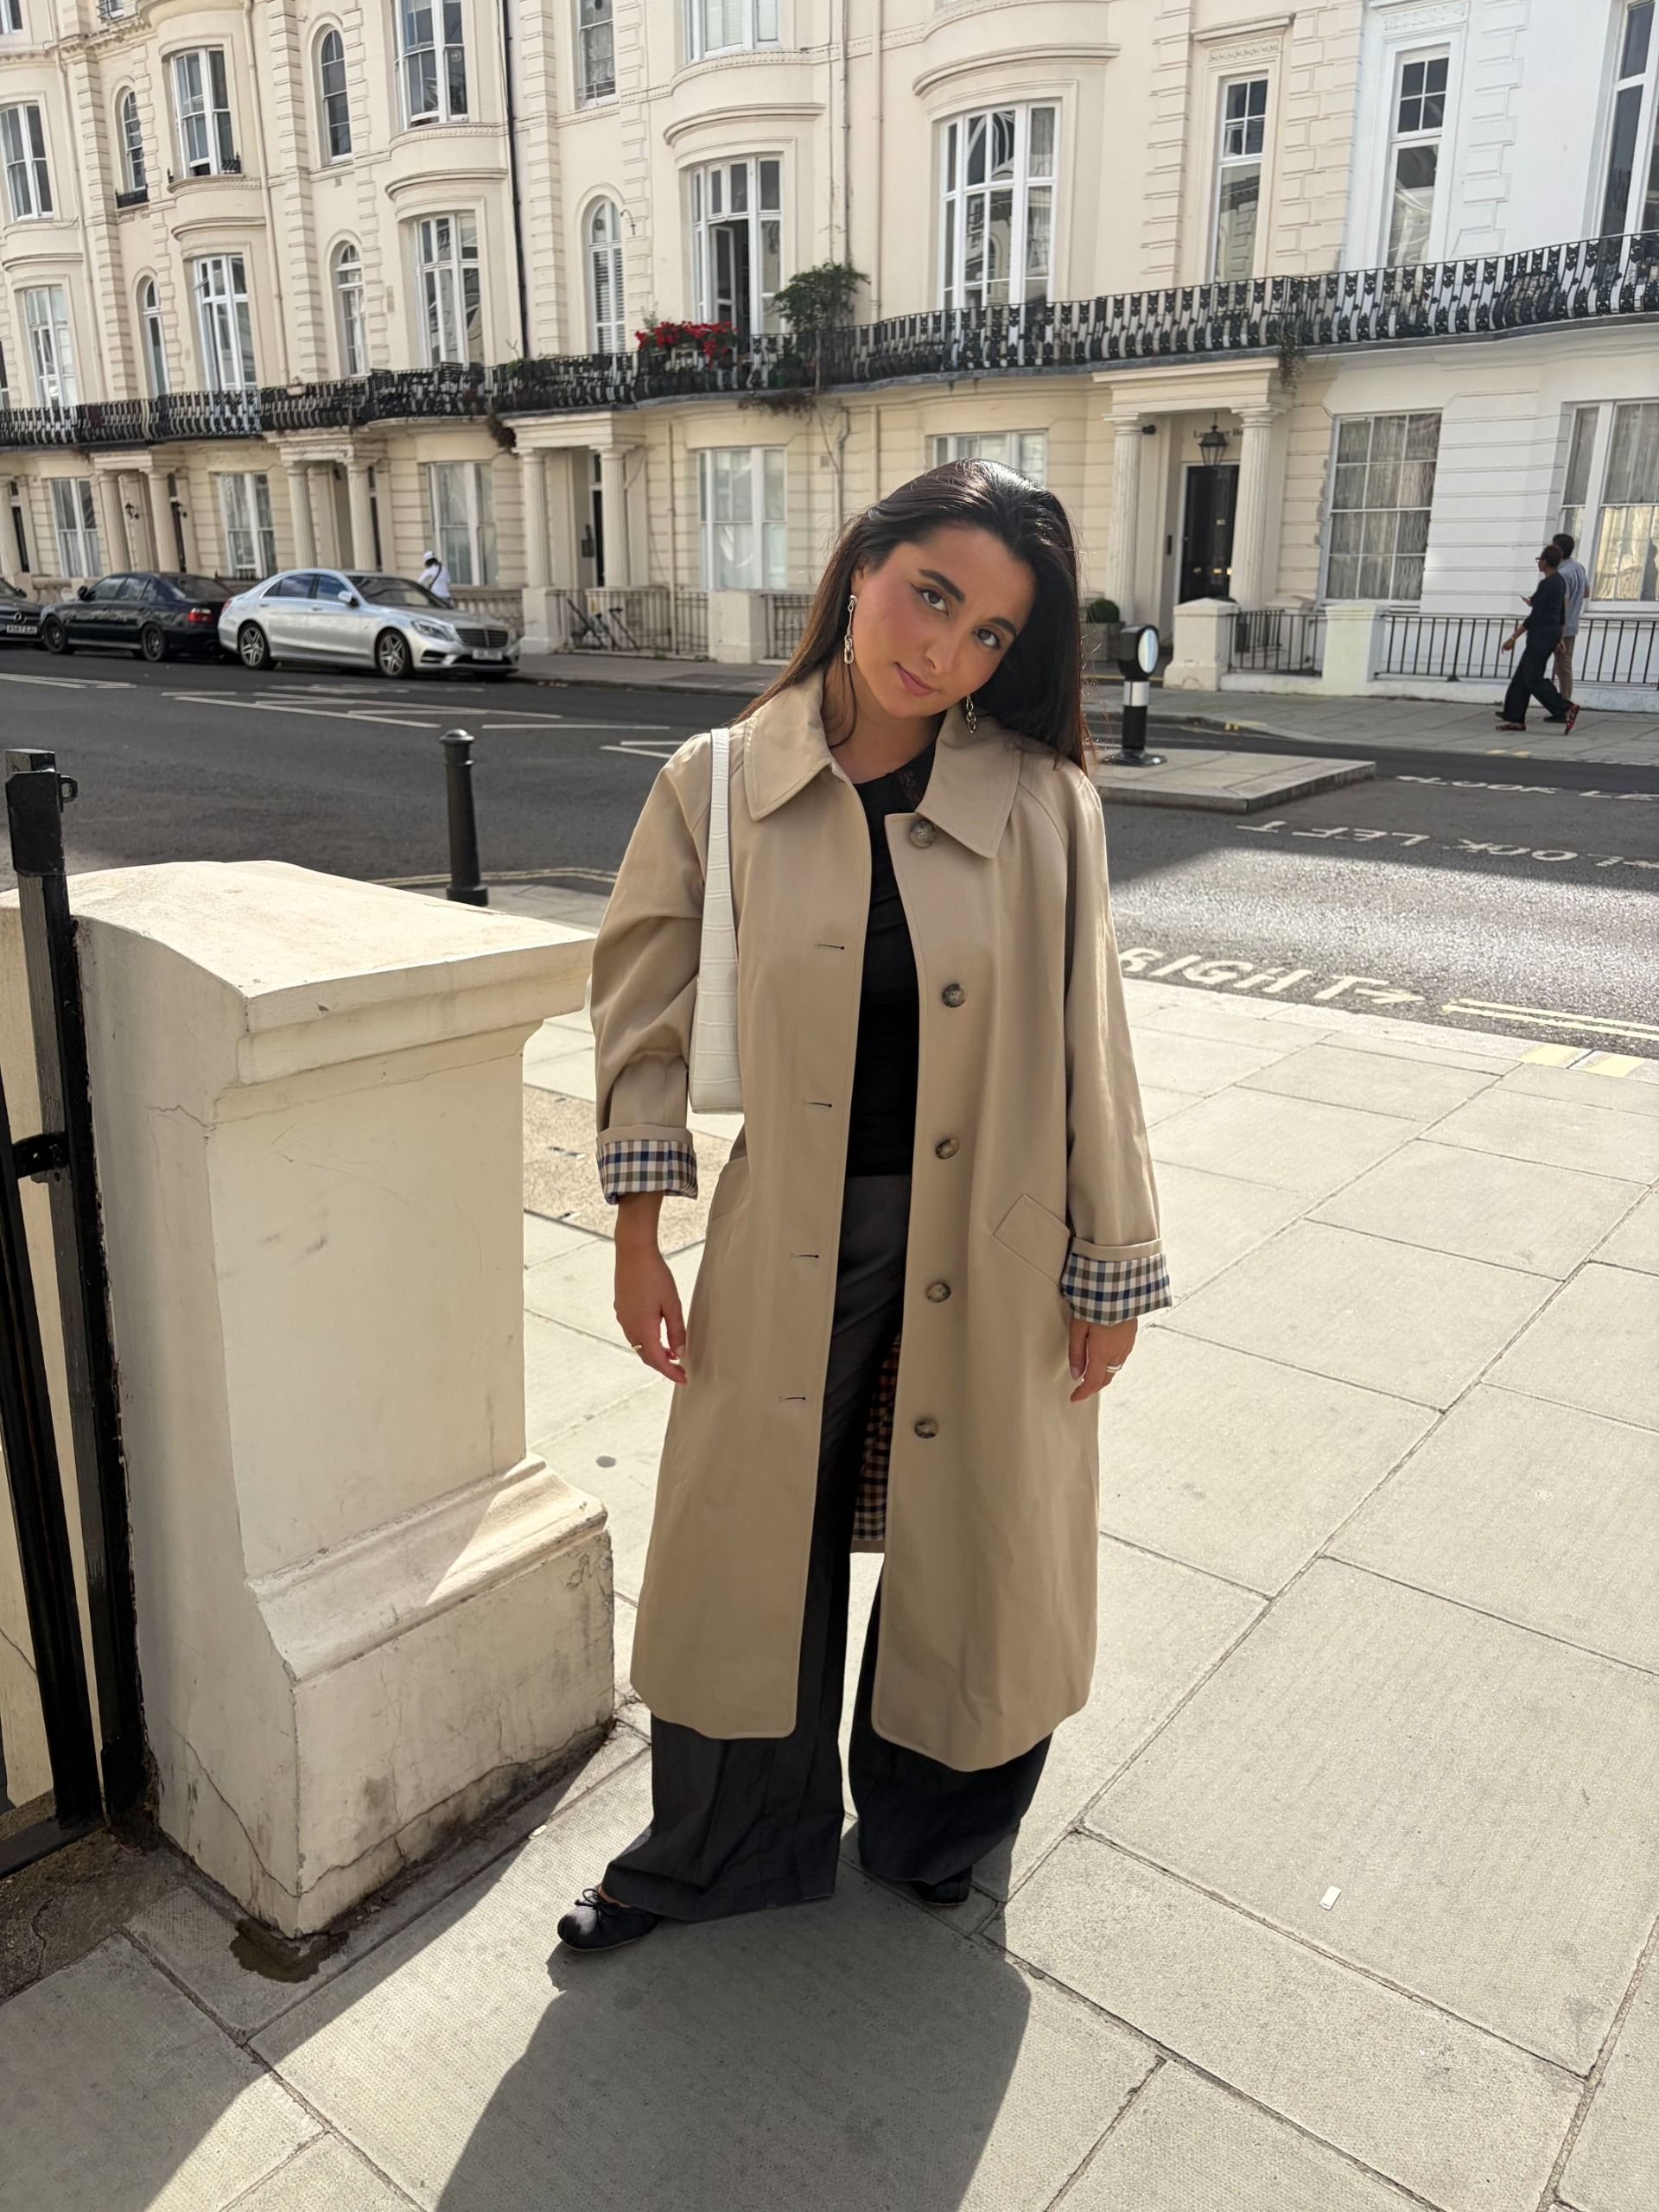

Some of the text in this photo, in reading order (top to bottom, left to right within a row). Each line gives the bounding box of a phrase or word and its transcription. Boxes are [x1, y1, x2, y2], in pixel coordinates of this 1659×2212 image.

[1416, 776, 1659, 801] LOOK LE
[1236, 820, 1624, 868] LOOK LEFT
[1118, 947, 1389, 1001] RIGHT
